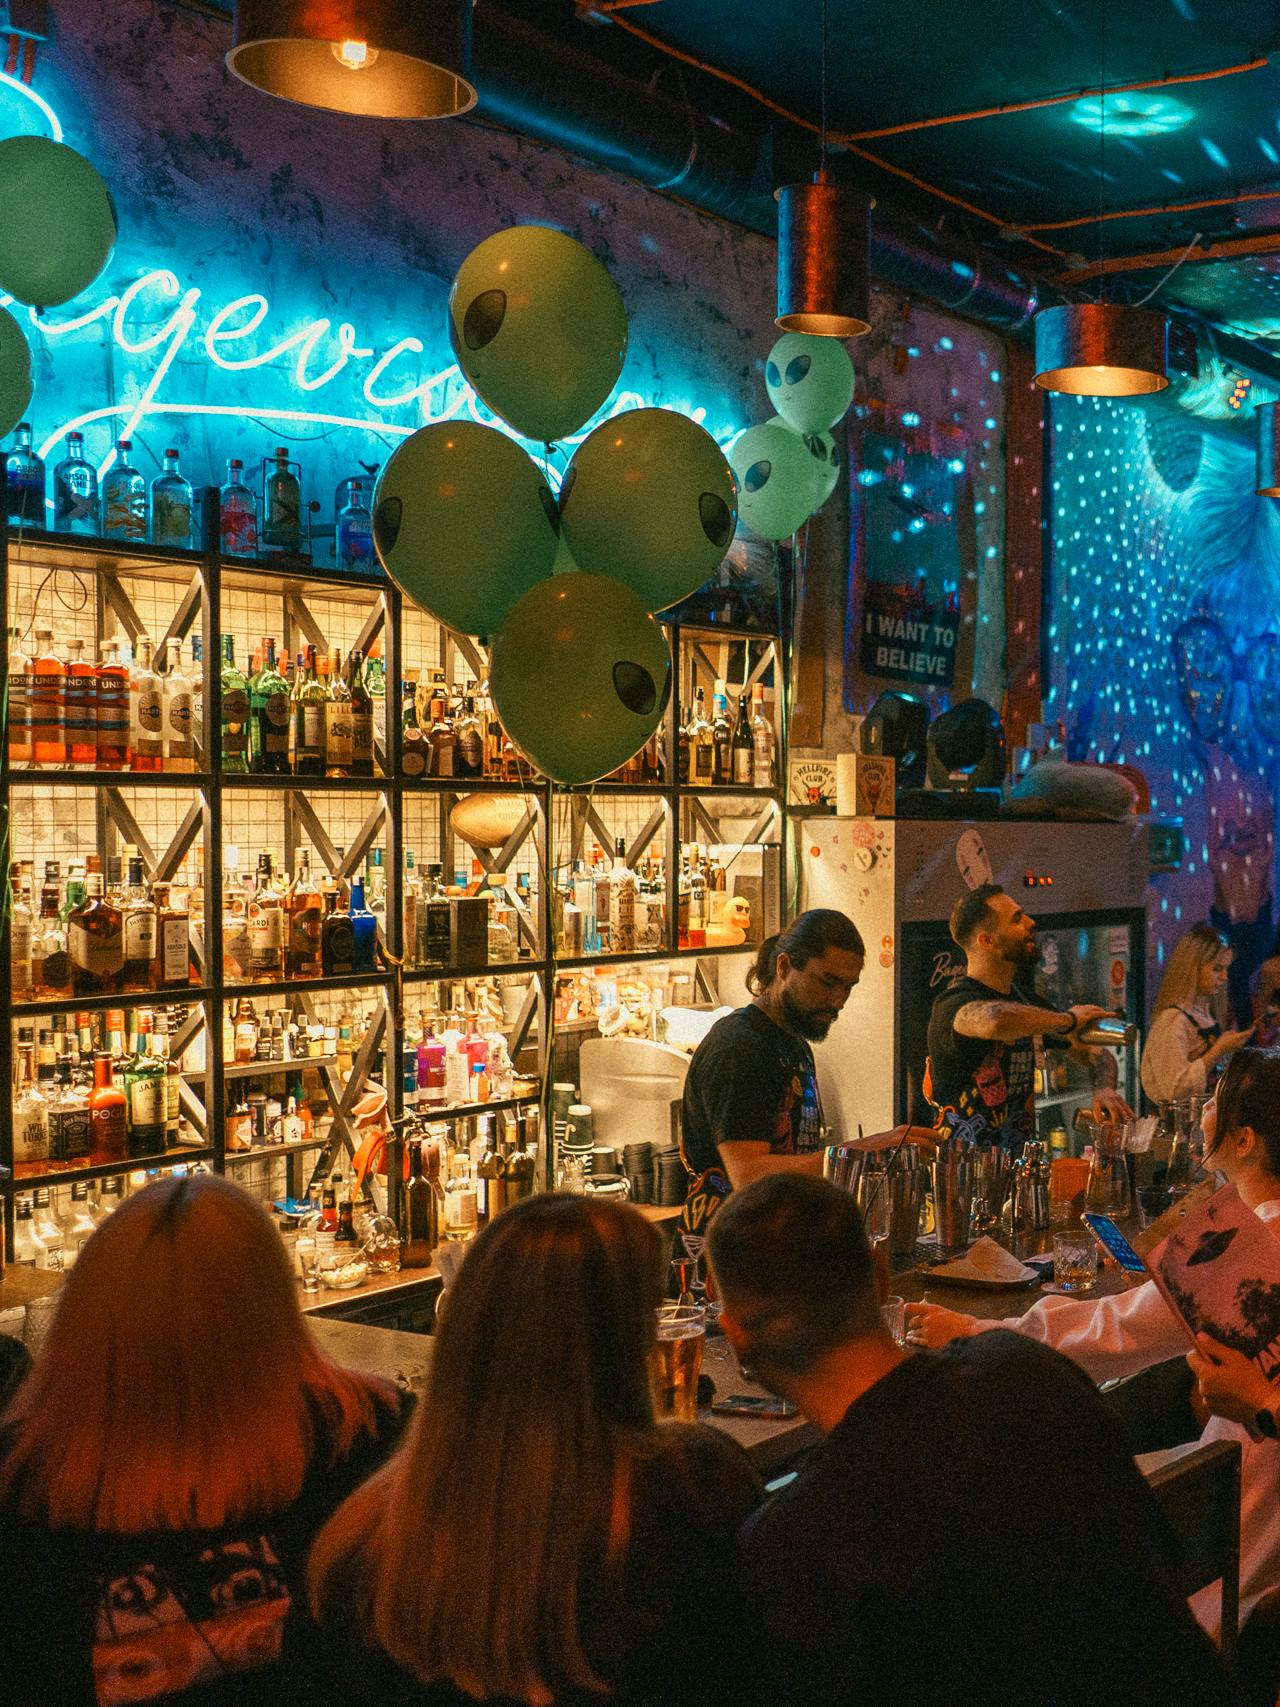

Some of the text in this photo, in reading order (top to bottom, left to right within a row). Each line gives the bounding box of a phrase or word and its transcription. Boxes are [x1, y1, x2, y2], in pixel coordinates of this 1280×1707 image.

[866, 613, 955, 648] I WANT TO
[876, 646, 947, 676] BELIEVE
